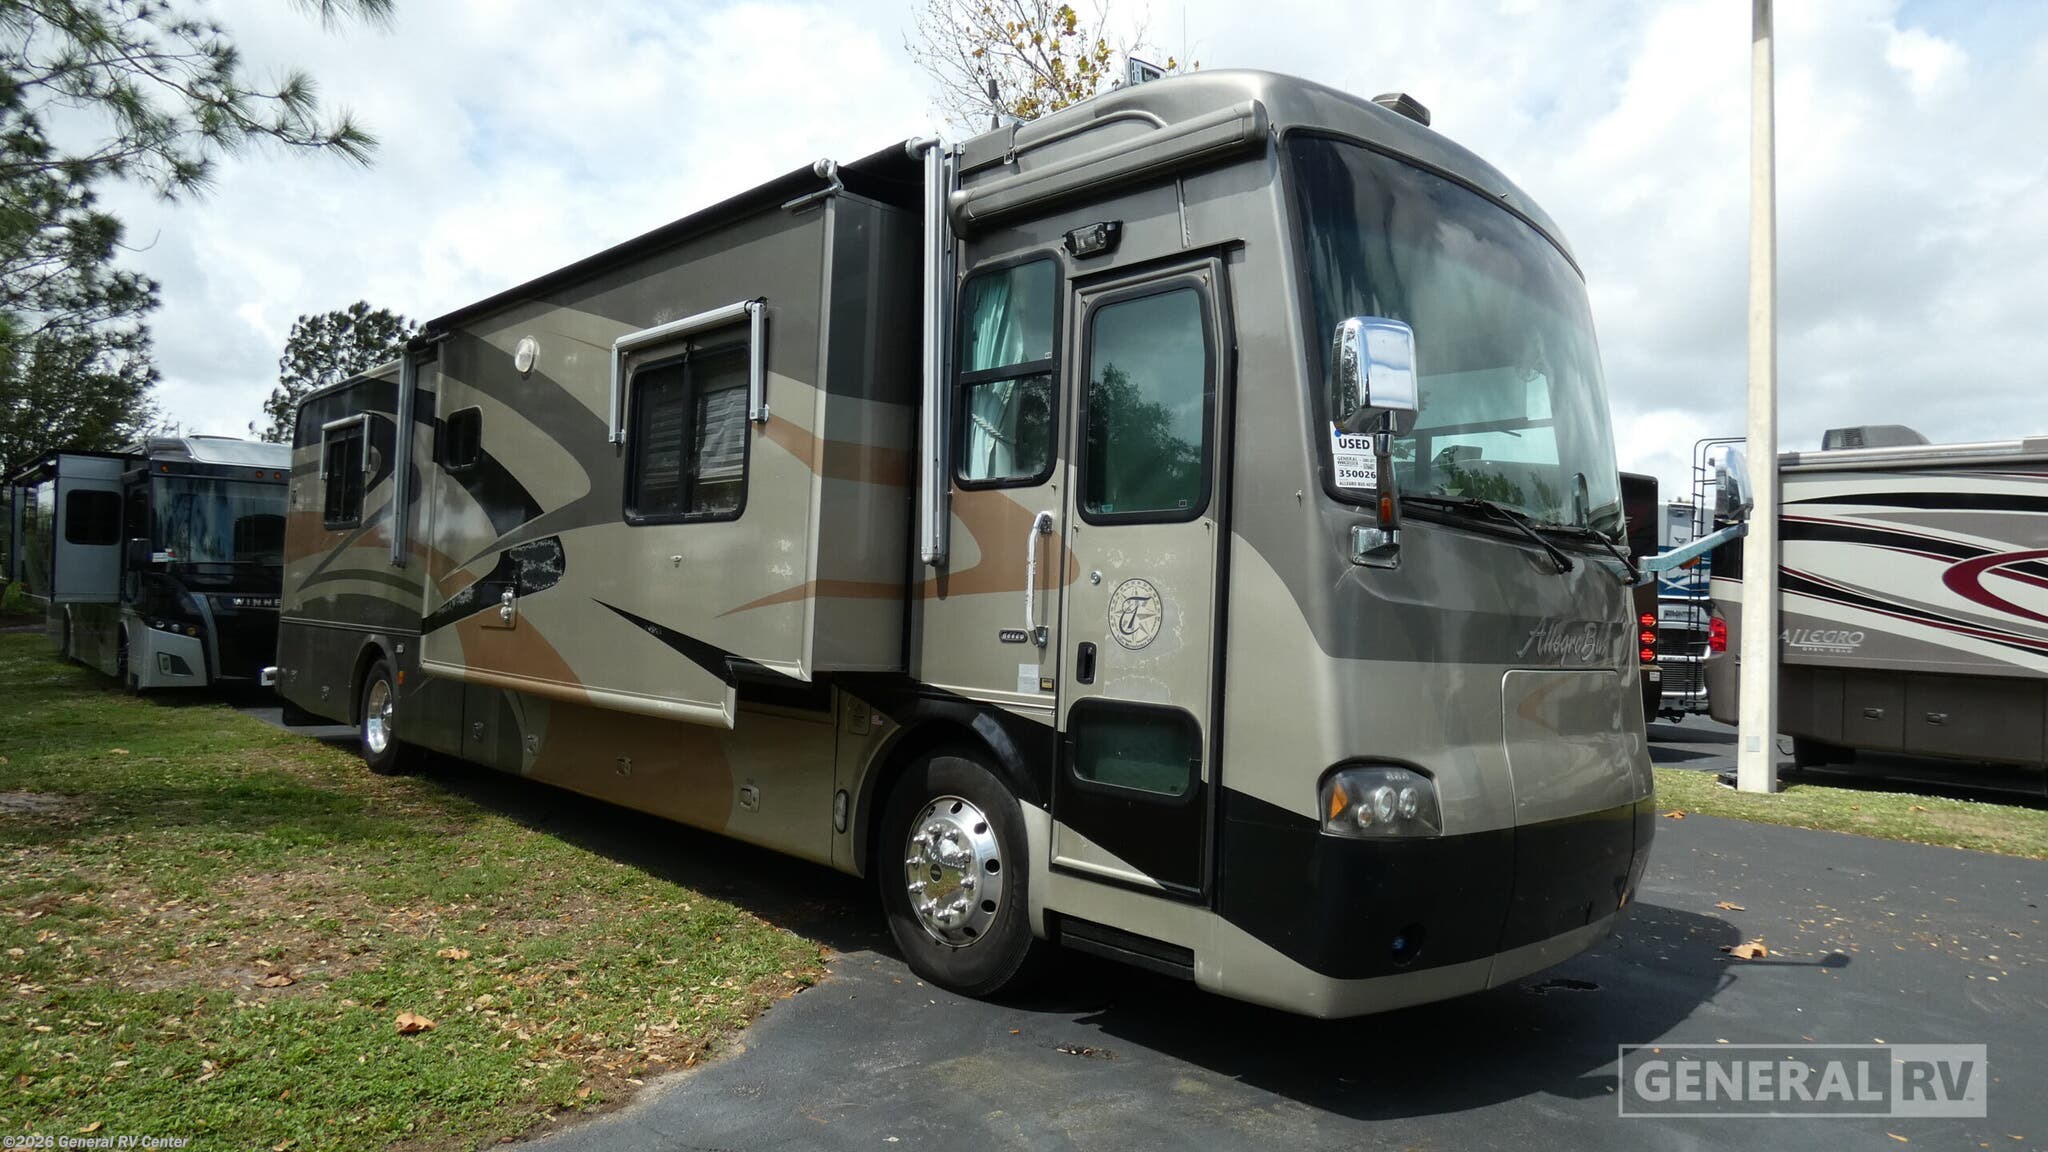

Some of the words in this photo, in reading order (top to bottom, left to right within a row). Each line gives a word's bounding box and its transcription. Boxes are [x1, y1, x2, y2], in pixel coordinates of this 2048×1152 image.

[1339, 438, 1370, 449] USED
[1339, 470, 1376, 479] 350026
[1779, 628, 1864, 646] ALLEGRO
